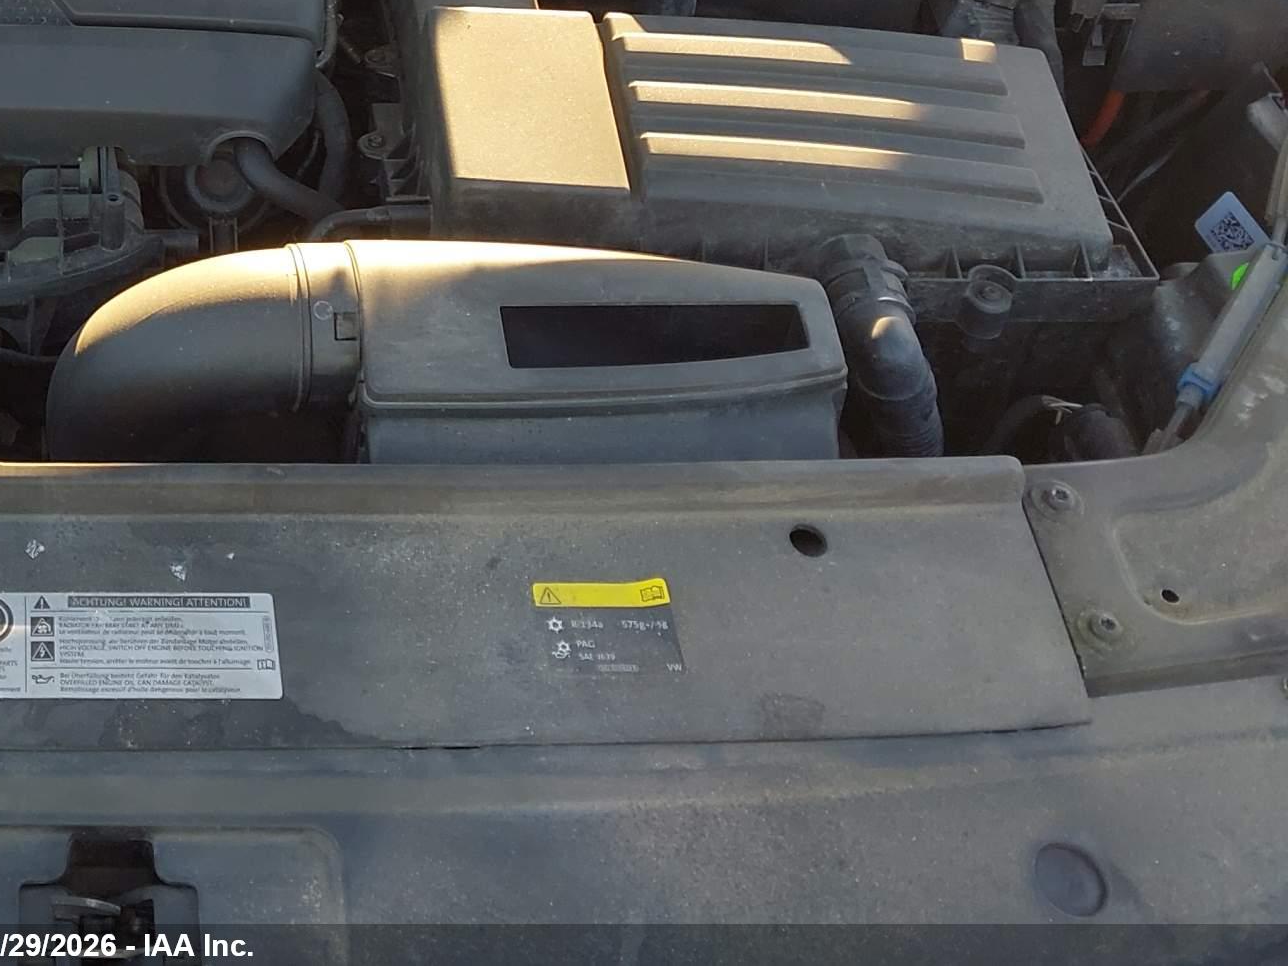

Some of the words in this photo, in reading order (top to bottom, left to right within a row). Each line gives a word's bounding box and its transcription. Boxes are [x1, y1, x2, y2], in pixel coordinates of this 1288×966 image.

[72, 597, 127, 607] ACHTUNG!
[130, 597, 183, 607] WARNING!
[185, 597, 247, 607] ATTENTION!
